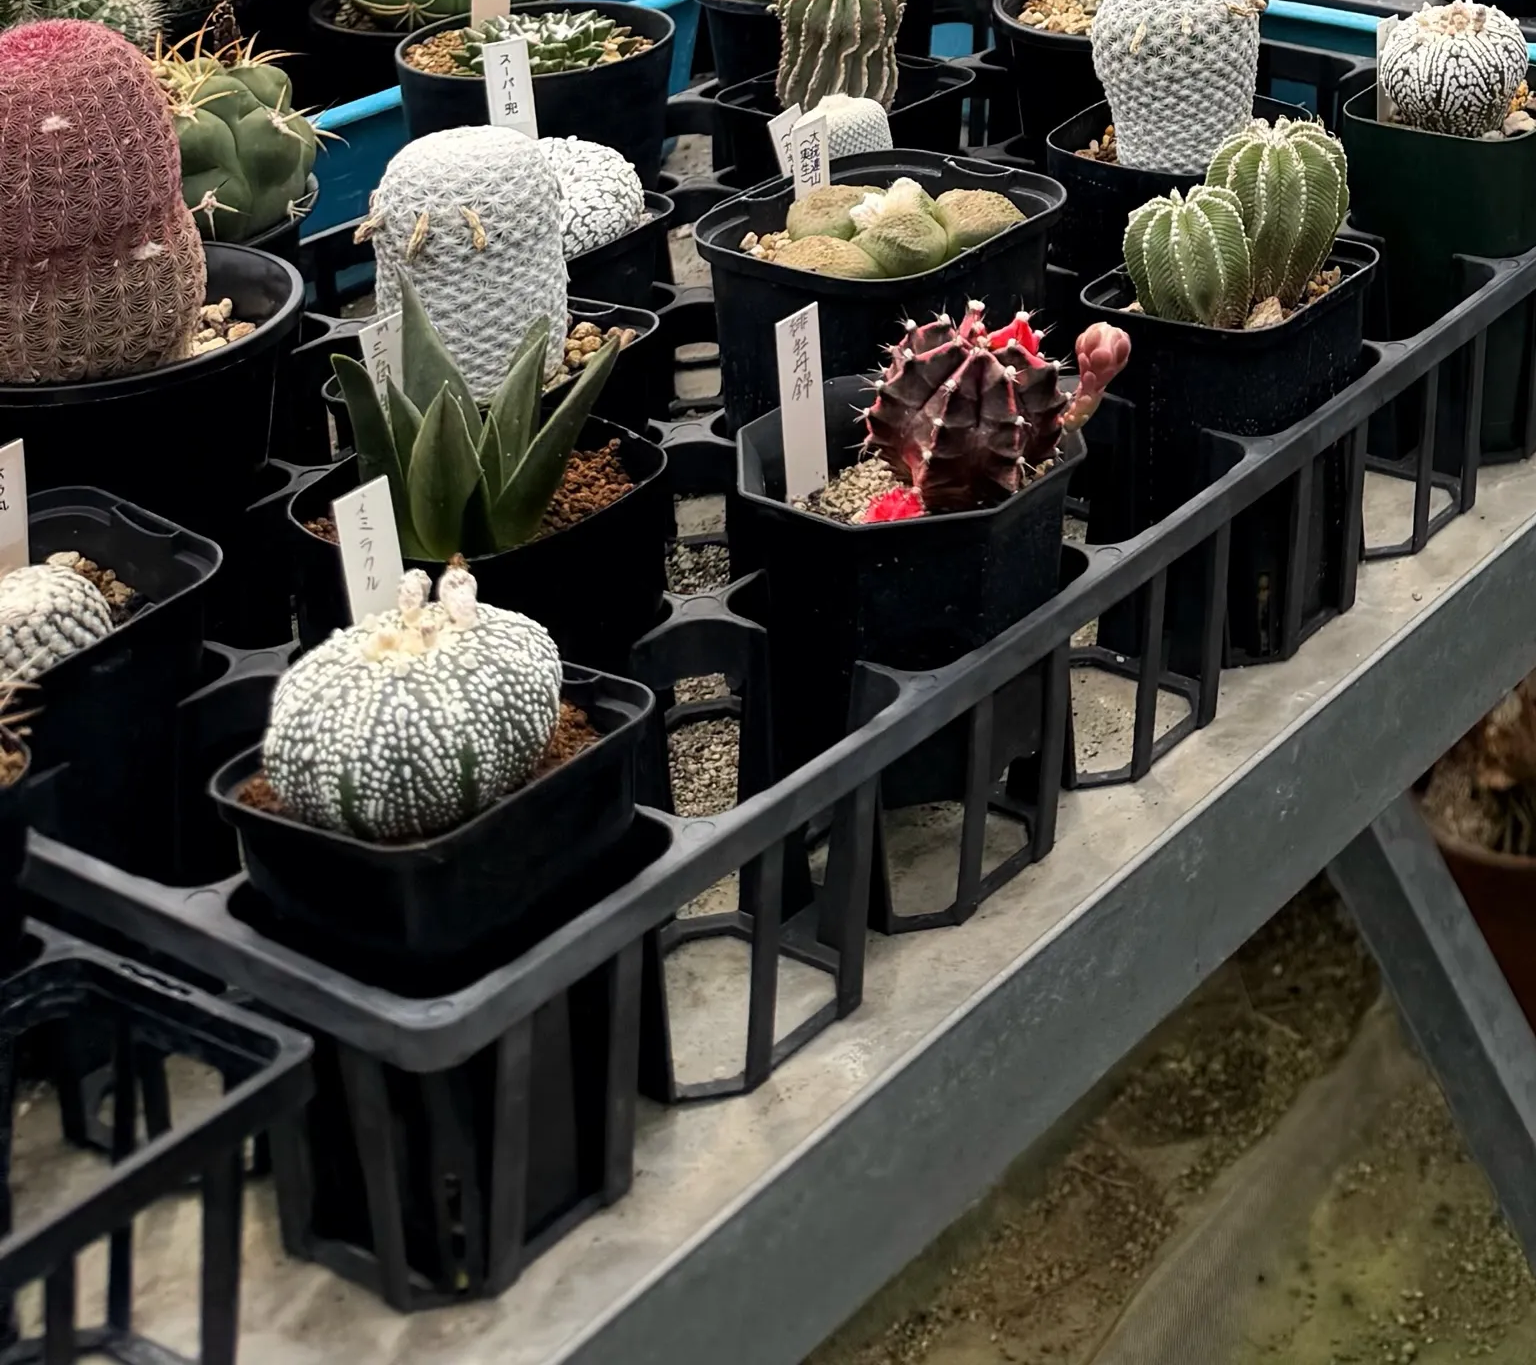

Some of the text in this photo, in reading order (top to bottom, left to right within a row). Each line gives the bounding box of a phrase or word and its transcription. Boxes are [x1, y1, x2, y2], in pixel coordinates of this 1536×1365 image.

[500, 54, 519, 116] スーパー兜
